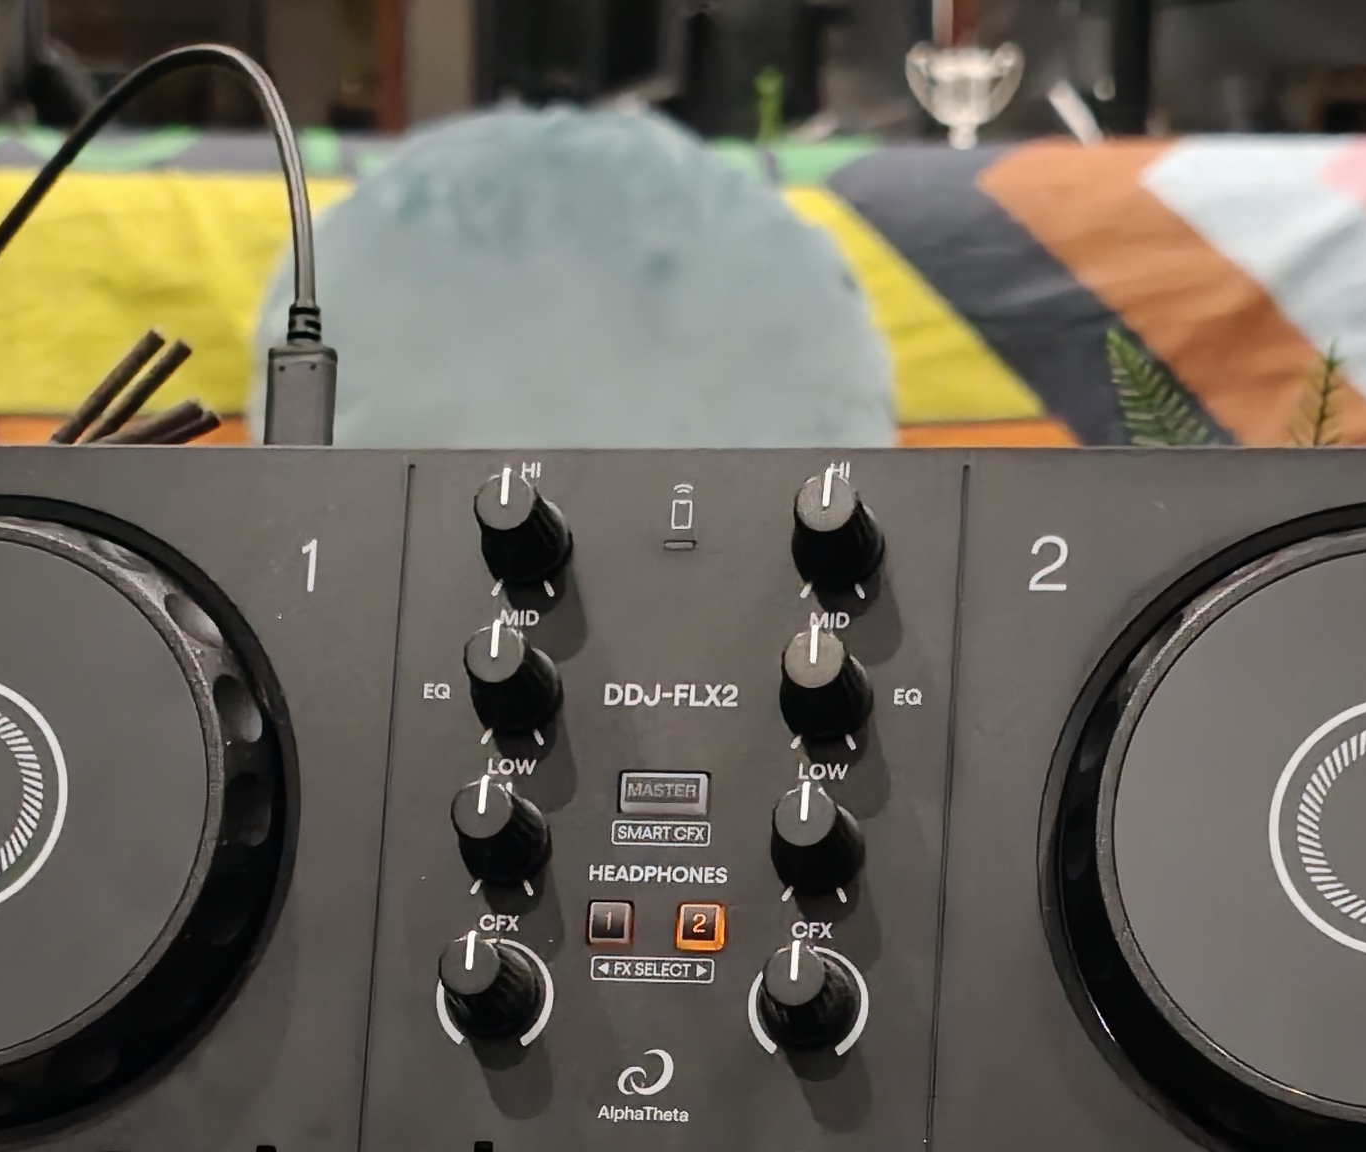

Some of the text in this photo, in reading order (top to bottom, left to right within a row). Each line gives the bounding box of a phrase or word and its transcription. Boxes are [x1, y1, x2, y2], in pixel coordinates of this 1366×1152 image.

[520, 461, 542, 480] HI
[301, 538, 318, 593] 1
[1028, 535, 1069, 592] 2
[498, 608, 540, 628] MID
[809, 611, 850, 630] MID
[423, 682, 451, 700] EQ
[604, 682, 739, 707] DDJ-FLX2
[893, 687, 923, 706] EQ
[486, 757, 537, 776] LOW
[797, 762, 849, 781] LOW
[627, 782, 697, 798] MASTER
[617, 825, 705, 841] SMART CFX
[589, 864, 728, 884] HEADPHONES
[478, 914, 519, 933] CFX
[692, 913, 707, 933] 2
[791, 920, 833, 940] CFX
[613, 961, 692, 978] FX SELECT
[597, 1104, 689, 1123] AlphaTheta
